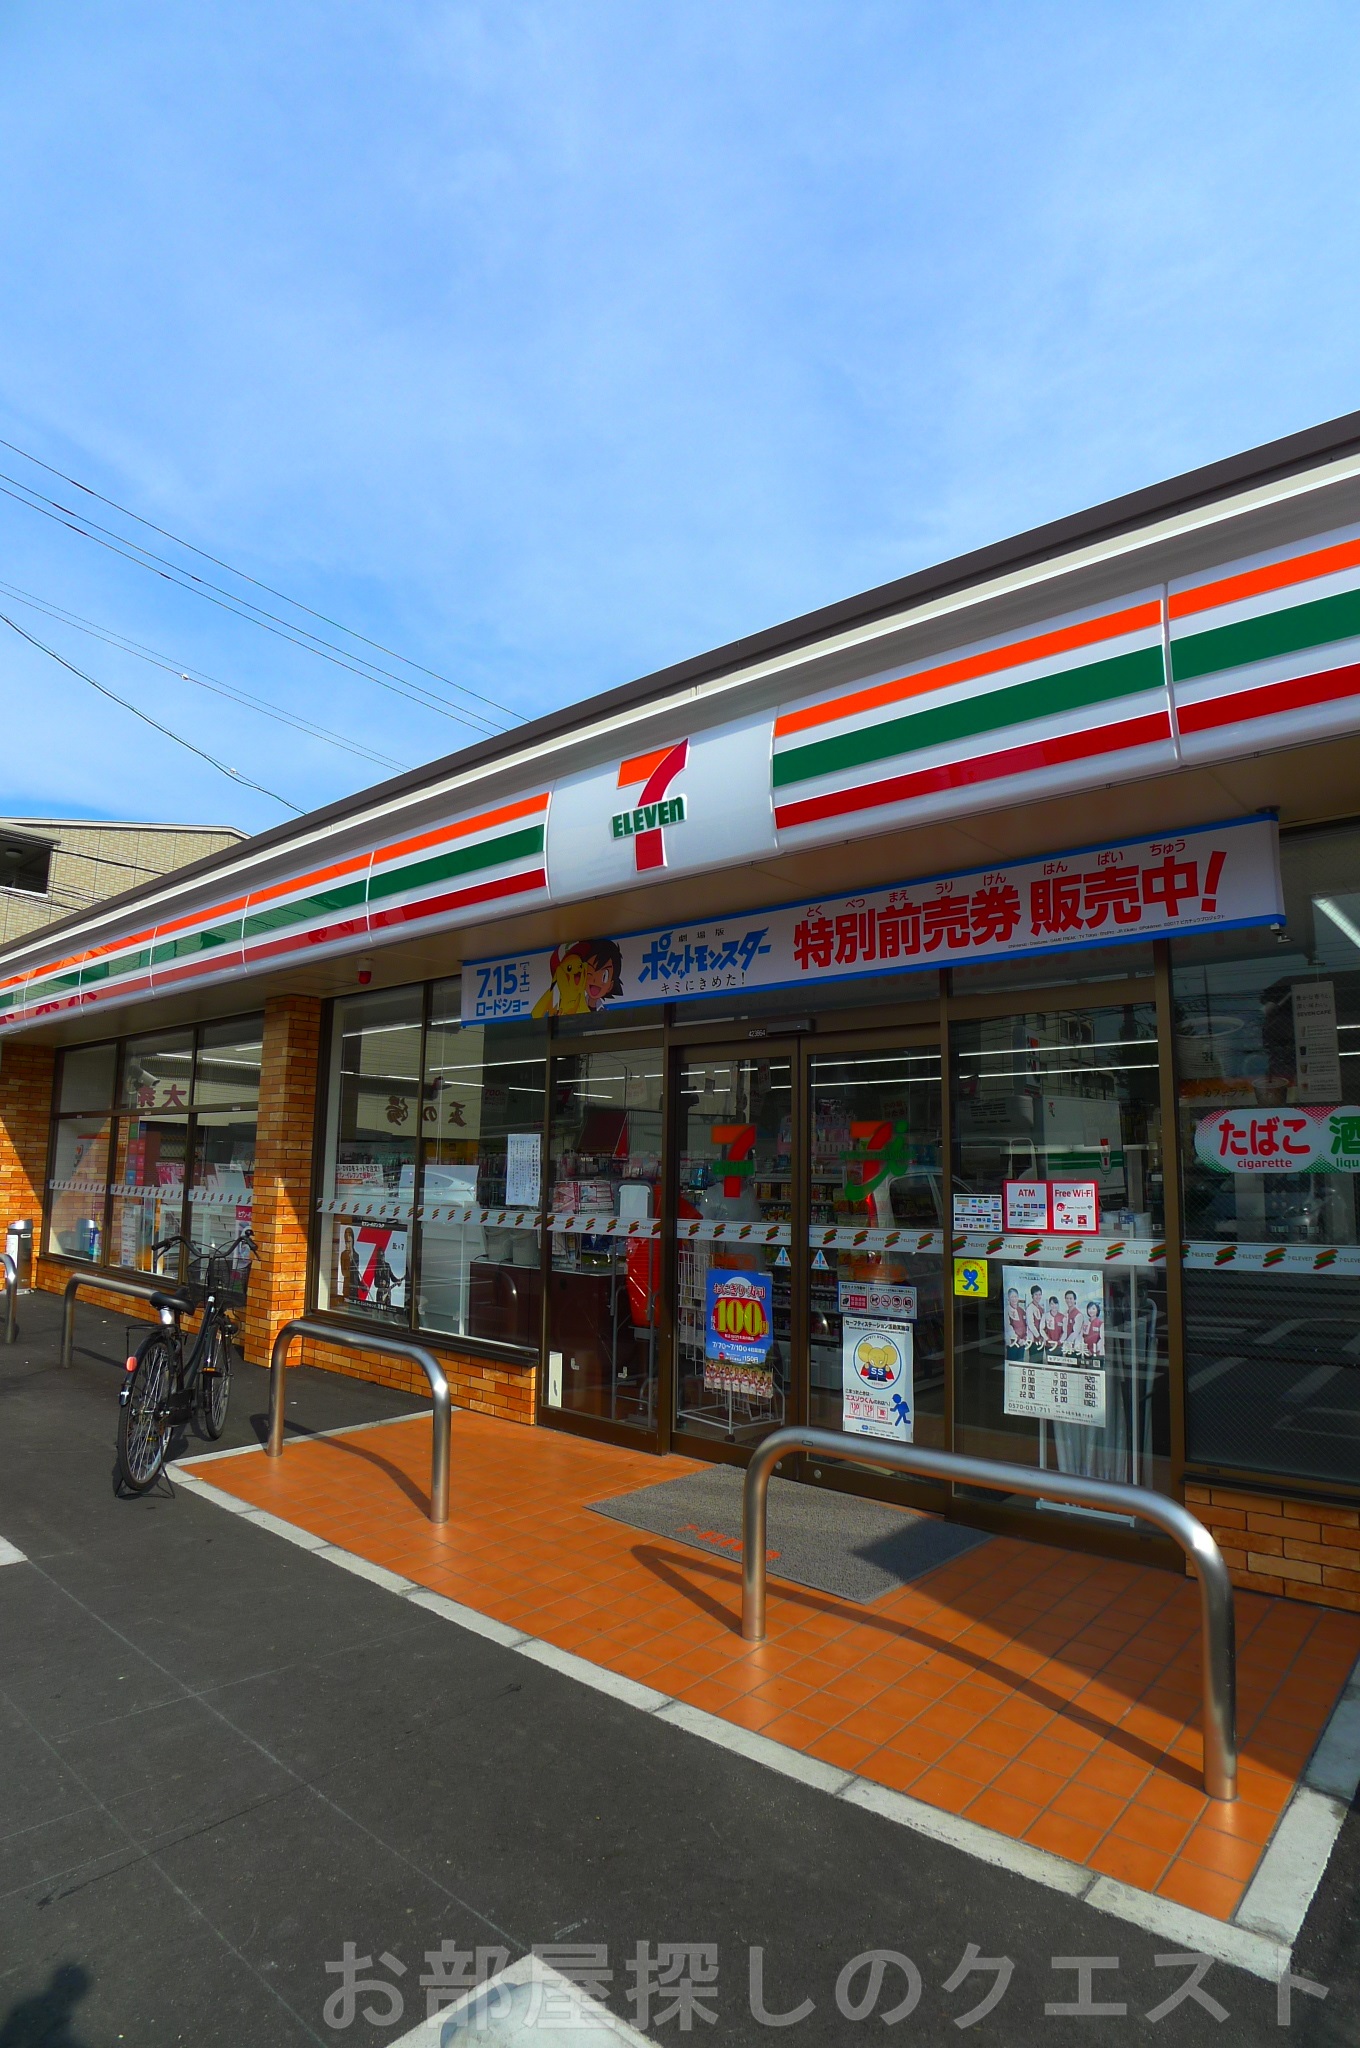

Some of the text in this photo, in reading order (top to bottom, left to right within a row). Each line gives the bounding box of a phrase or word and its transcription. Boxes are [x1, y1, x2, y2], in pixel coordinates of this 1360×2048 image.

[806, 839, 1186, 918] とく べつ まえ うり けん はん ばい ちゅう
[678, 927, 725, 942] 劇場版
[793, 884, 1021, 970] 特別前売券
[637, 927, 772, 983] ポケットモンスター
[476, 963, 518, 999] 7.15
[660, 972, 745, 995] キミにきめた!
[476, 998, 530, 1017] ロードショー
[1218, 1116, 1311, 1156] たばこ
[1237, 1158, 1293, 1170] cigarette
[1017, 1188, 1036, 1197] ATM
[1054, 1189, 1094, 1198] Free Wi-Fi
[715, 1298, 762, 1337] 100
[870, 1367, 884, 1376] SS
